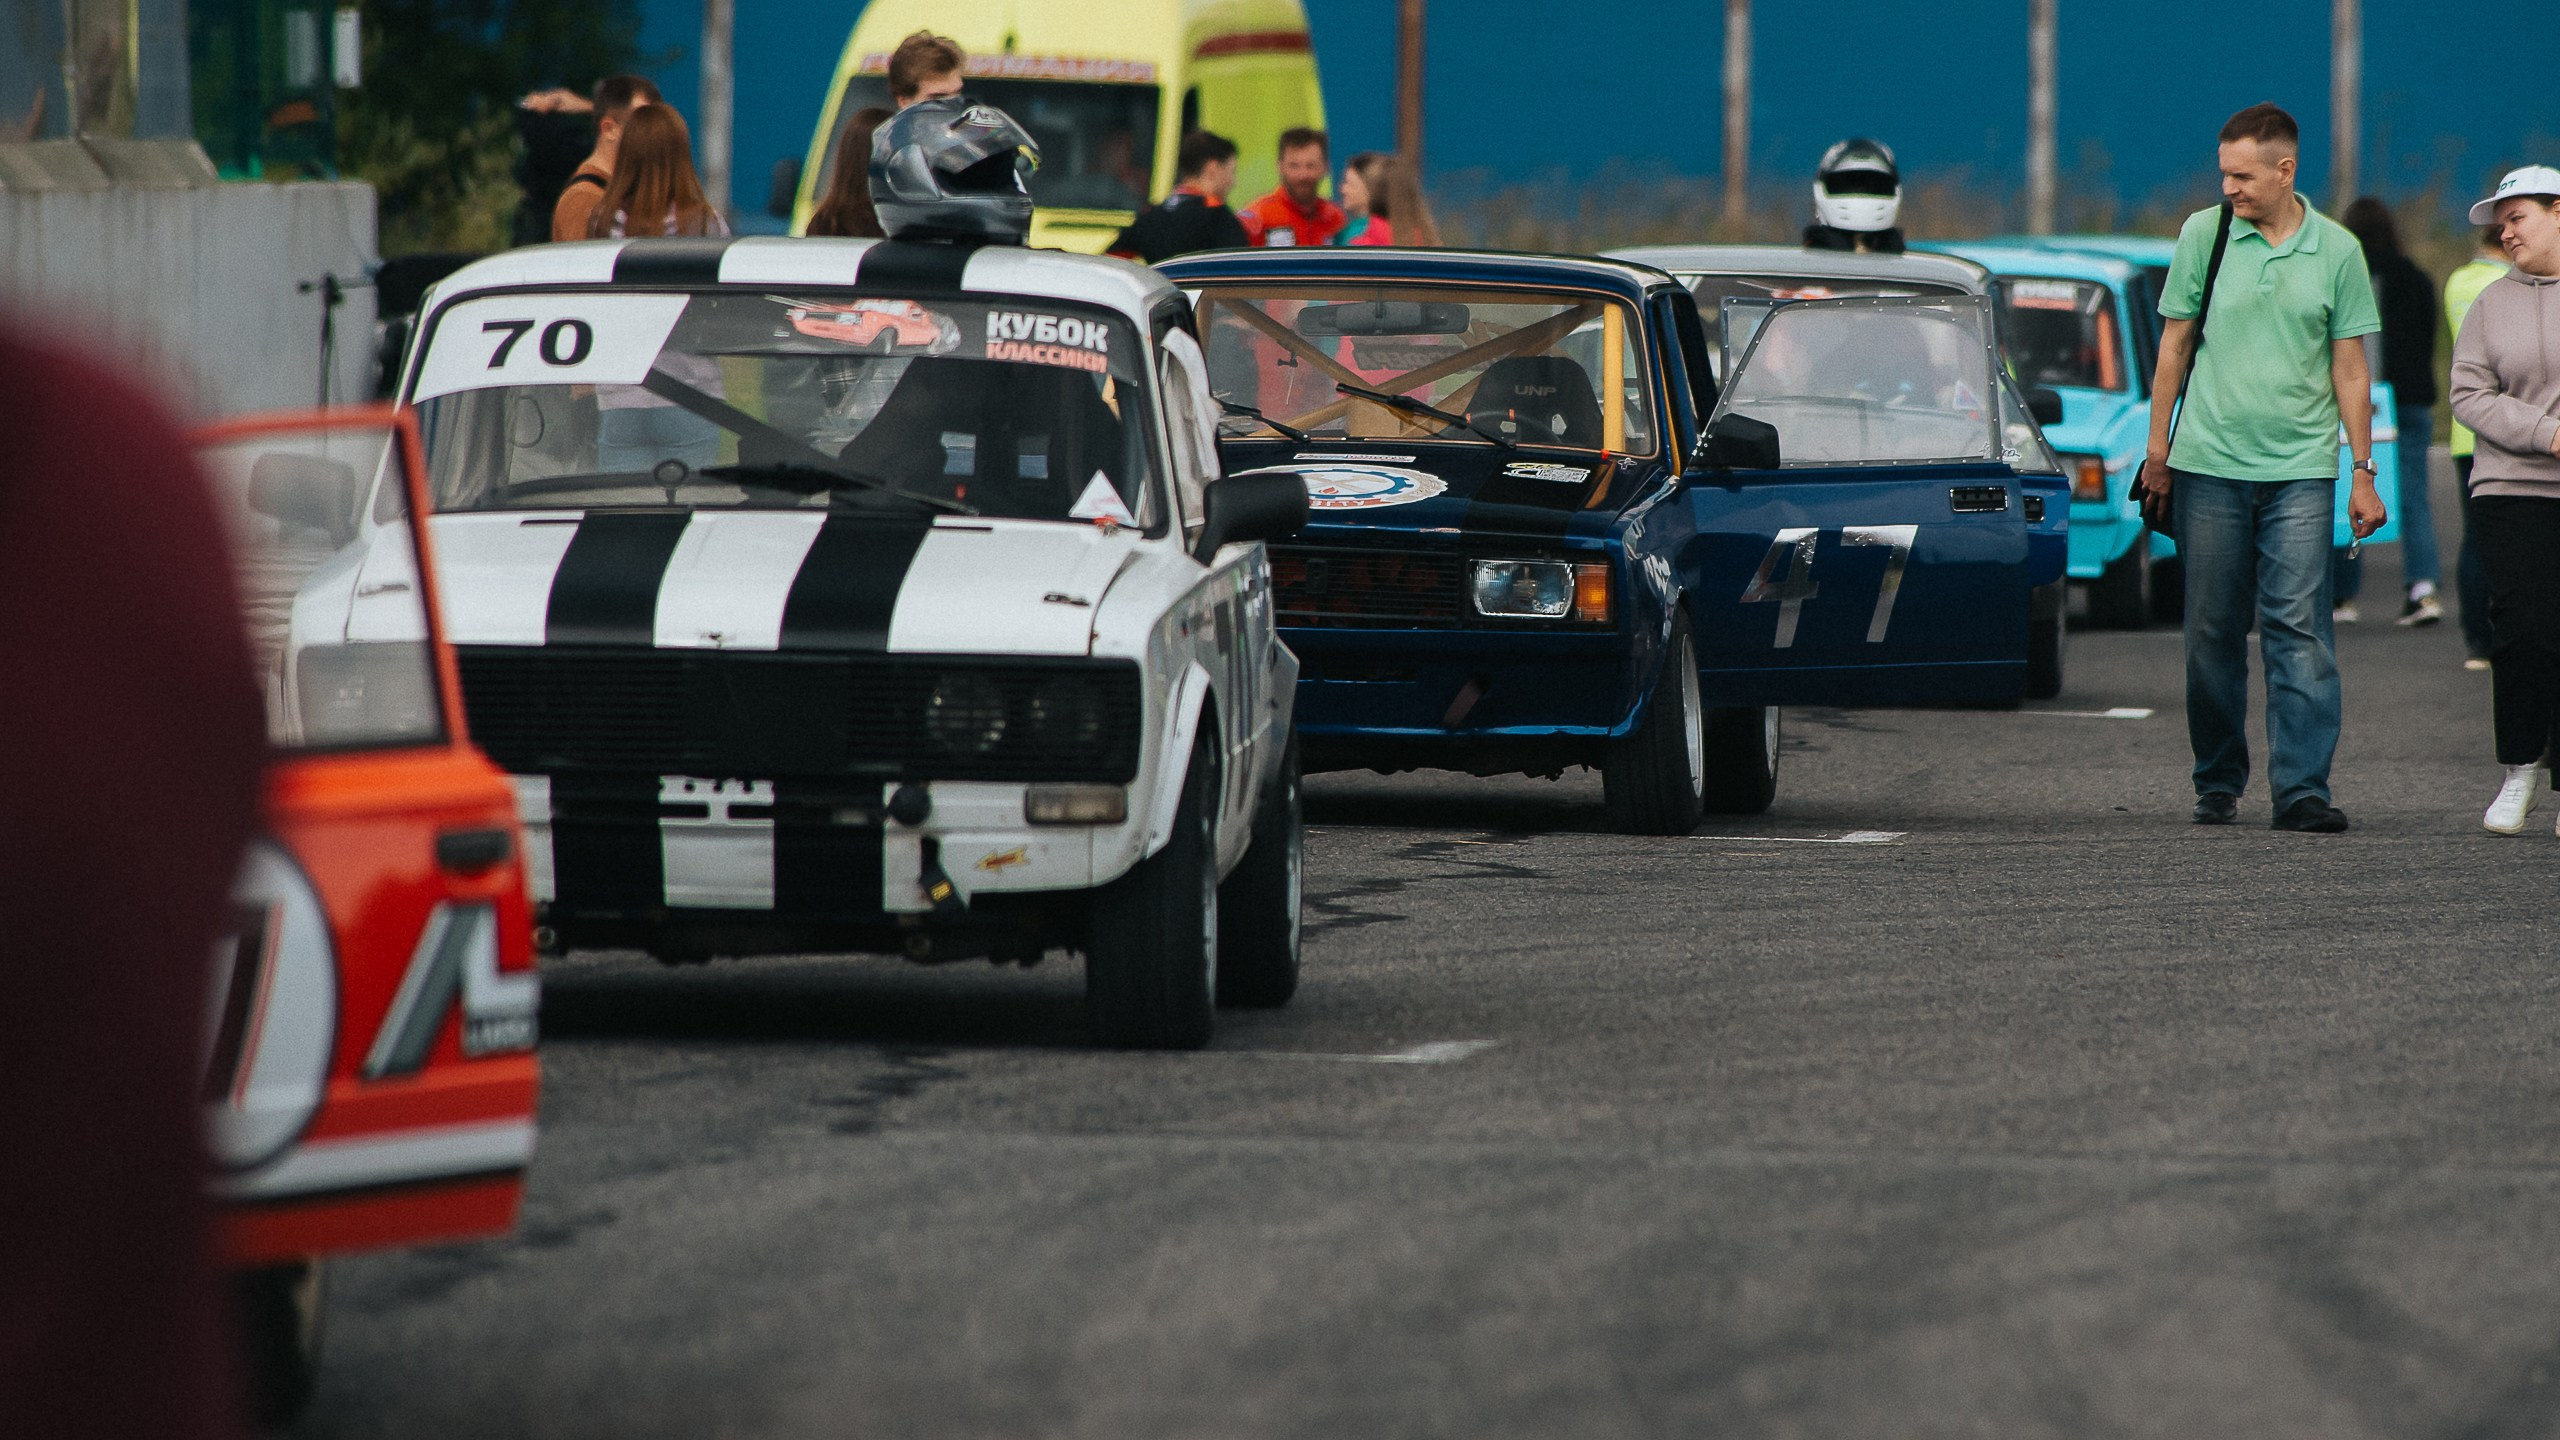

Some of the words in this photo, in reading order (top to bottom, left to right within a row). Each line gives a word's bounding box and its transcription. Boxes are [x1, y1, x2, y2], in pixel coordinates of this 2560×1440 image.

[481, 318, 594, 370] 70
[986, 311, 1109, 352] КУБОК
[986, 341, 1109, 374] КЛАССИКИ
[1739, 524, 1920, 649] 47
